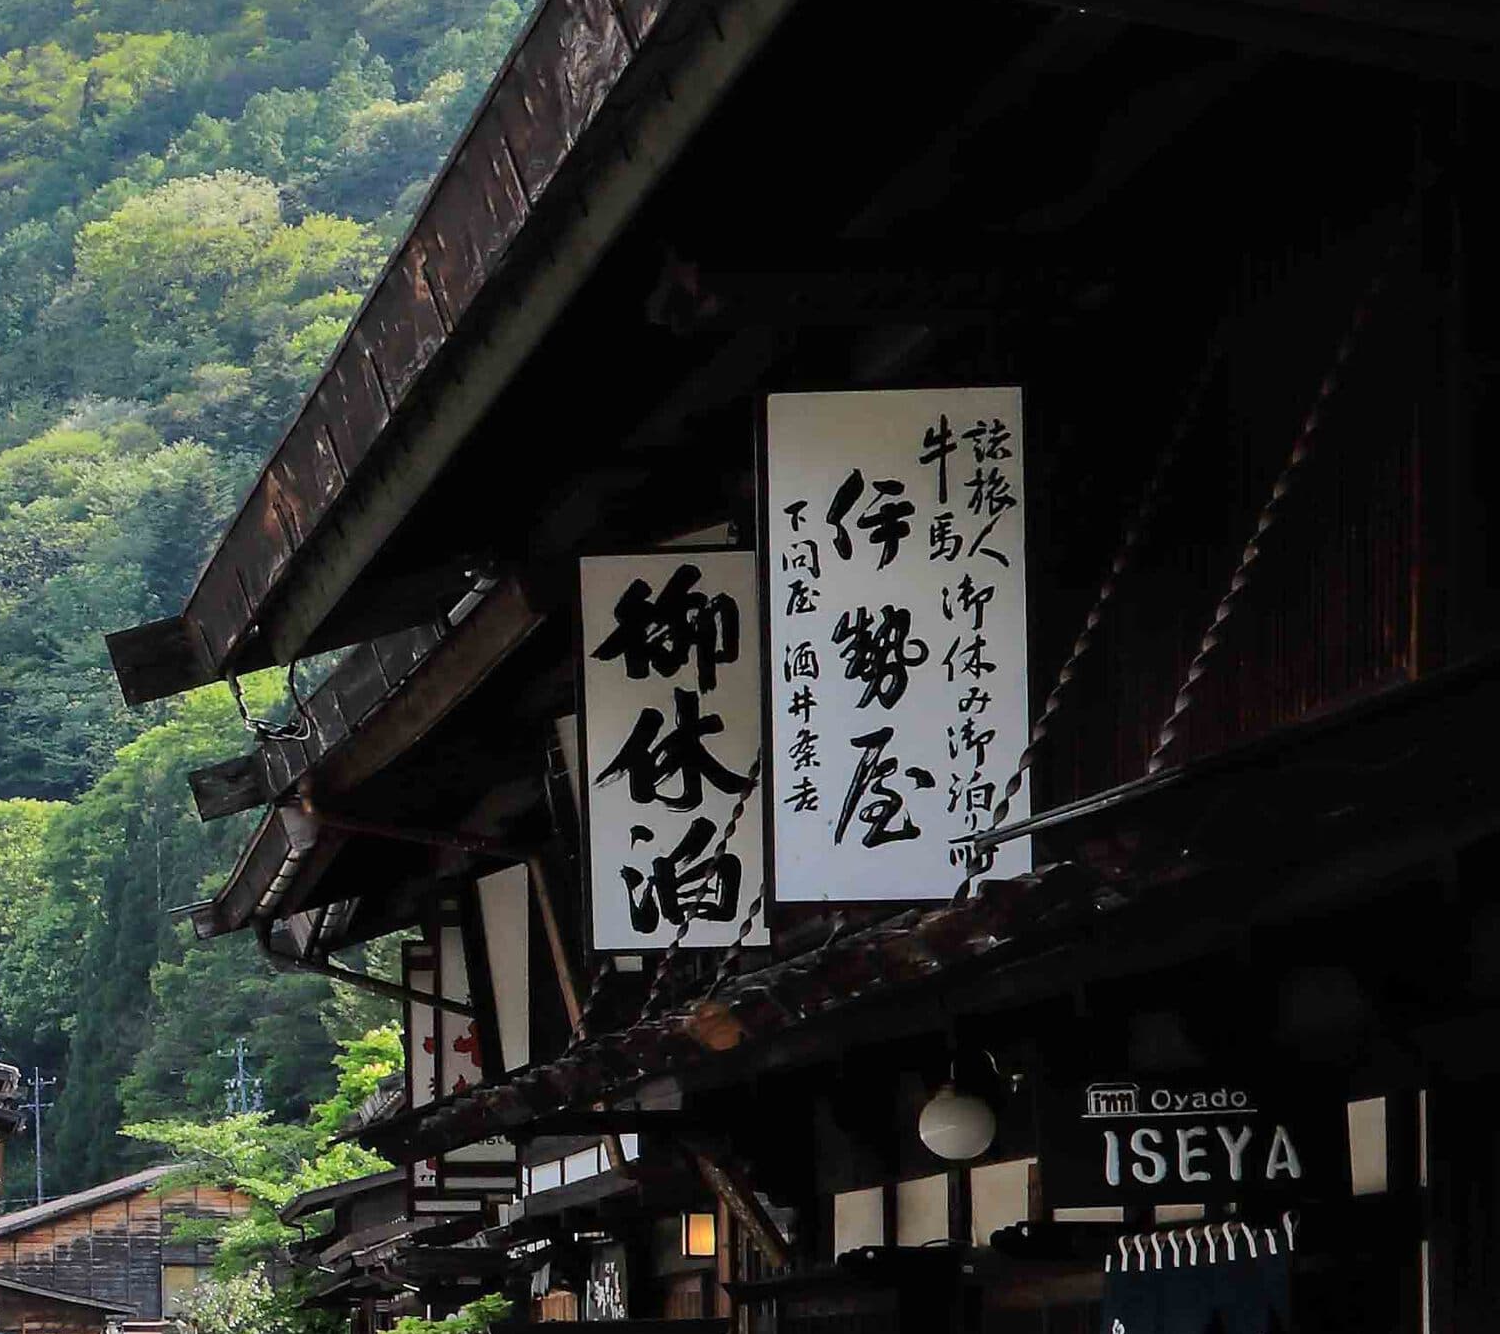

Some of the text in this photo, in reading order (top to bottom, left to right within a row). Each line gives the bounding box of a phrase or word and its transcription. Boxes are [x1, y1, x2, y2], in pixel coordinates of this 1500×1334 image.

[826, 467, 936, 848] 伊勢屋
[1150, 1088, 1248, 1111] Oyado
[1103, 1124, 1301, 1187] ISEYA
